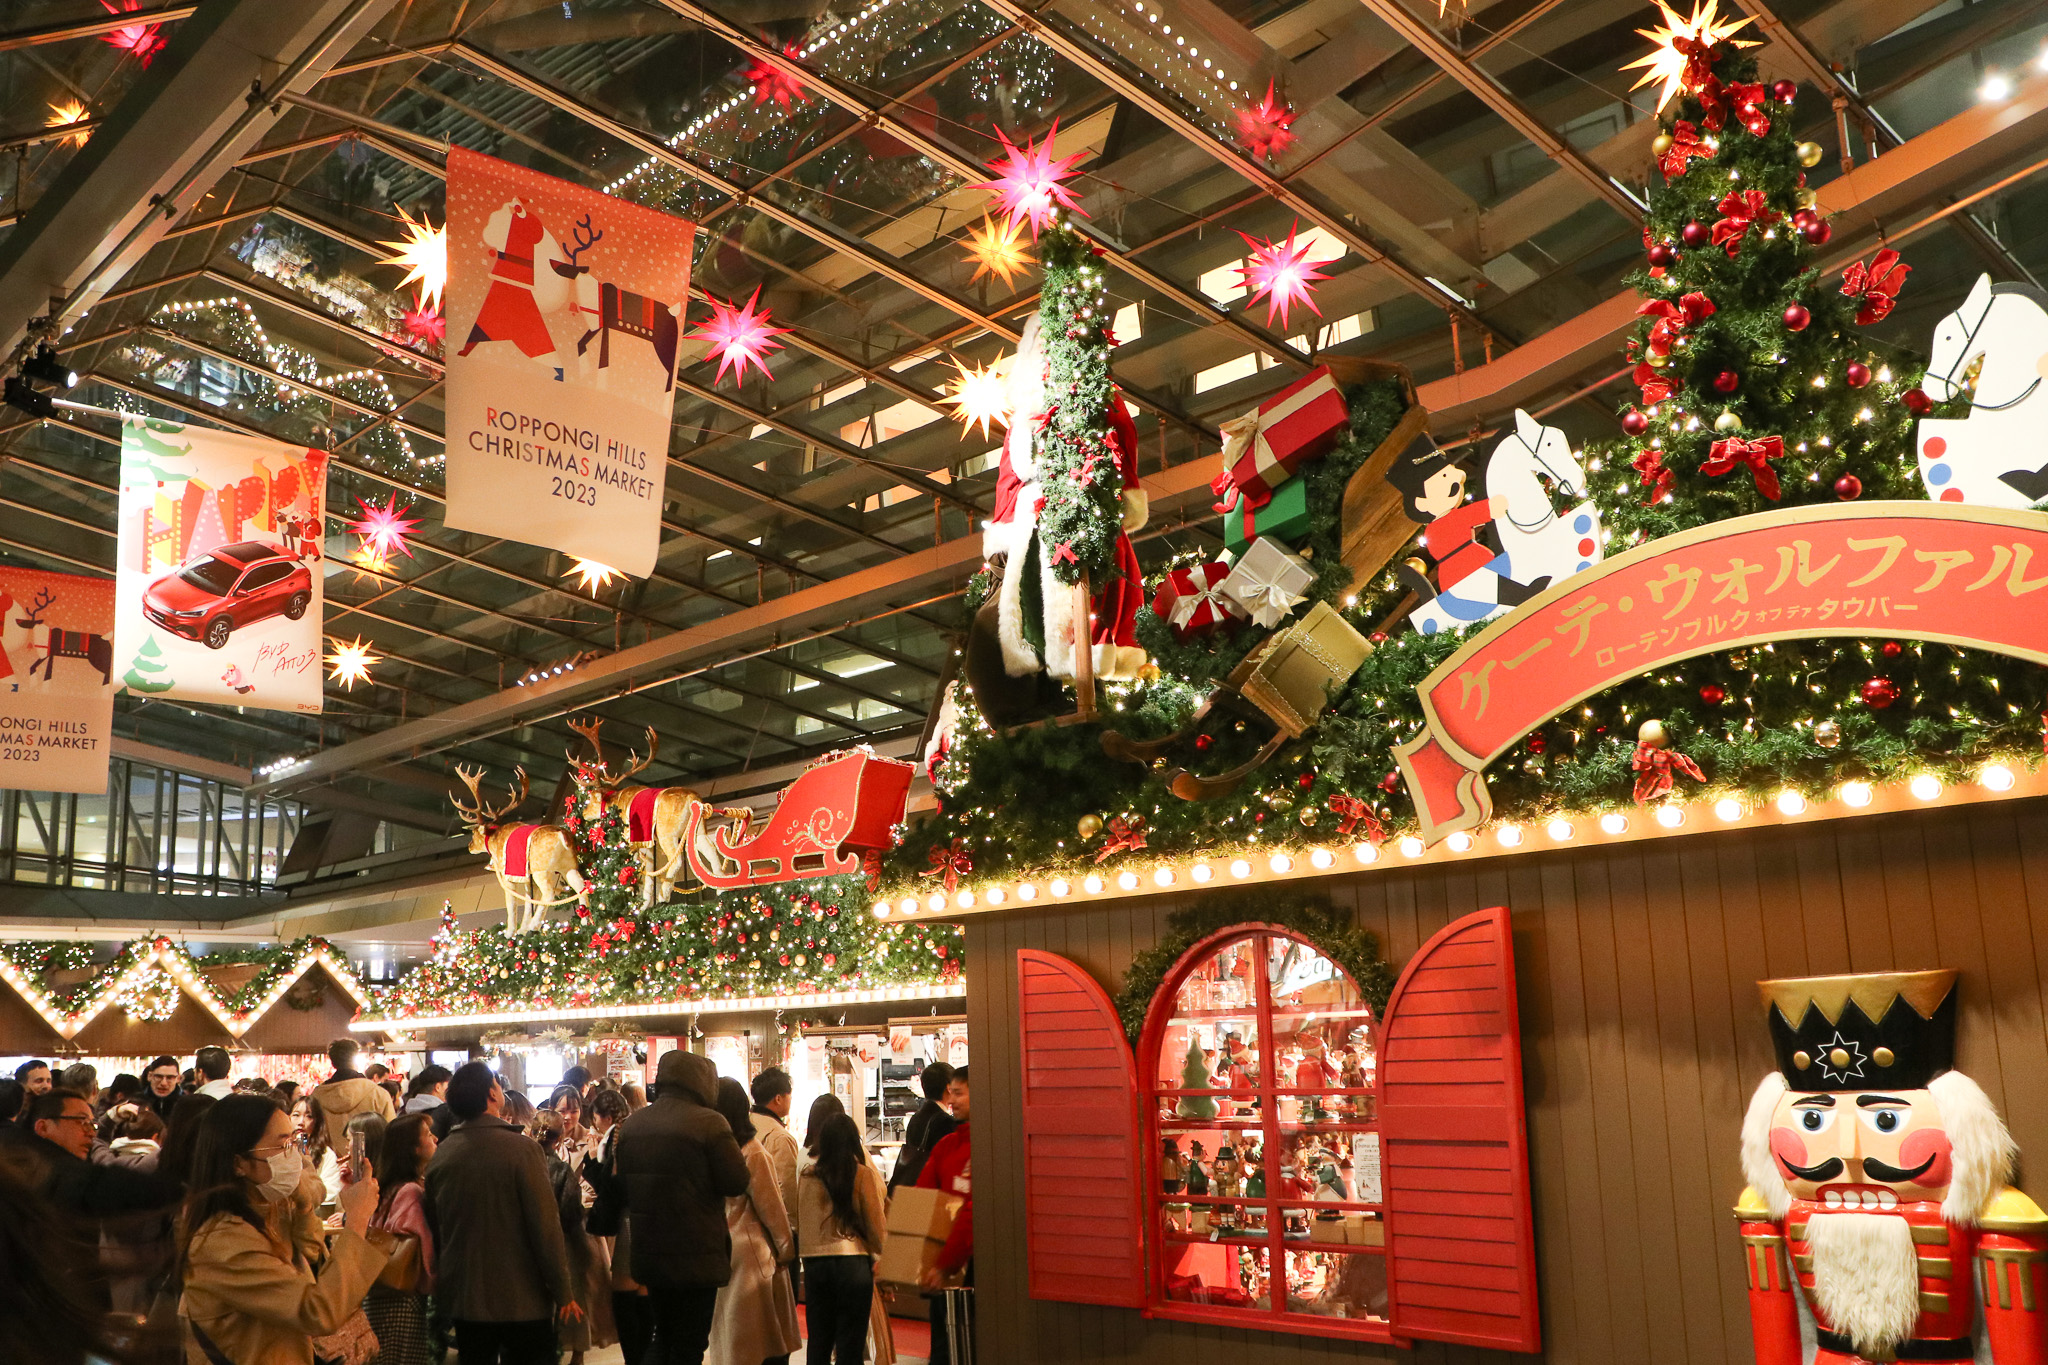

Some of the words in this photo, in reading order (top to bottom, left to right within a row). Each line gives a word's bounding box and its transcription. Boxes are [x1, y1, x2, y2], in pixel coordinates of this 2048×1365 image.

[486, 406, 600, 453] ROPPONGI
[607, 438, 647, 471] HILLS
[468, 430, 590, 477] CHRISTMAS
[594, 461, 654, 500] MARKET
[551, 476, 597, 507] 2023
[126, 448, 329, 574] HAPPY
[252, 642, 290, 673] BYD
[37, 735, 98, 750] MARKET
[48, 721, 88, 734] HILLS
[3, 748, 40, 762] 2023
